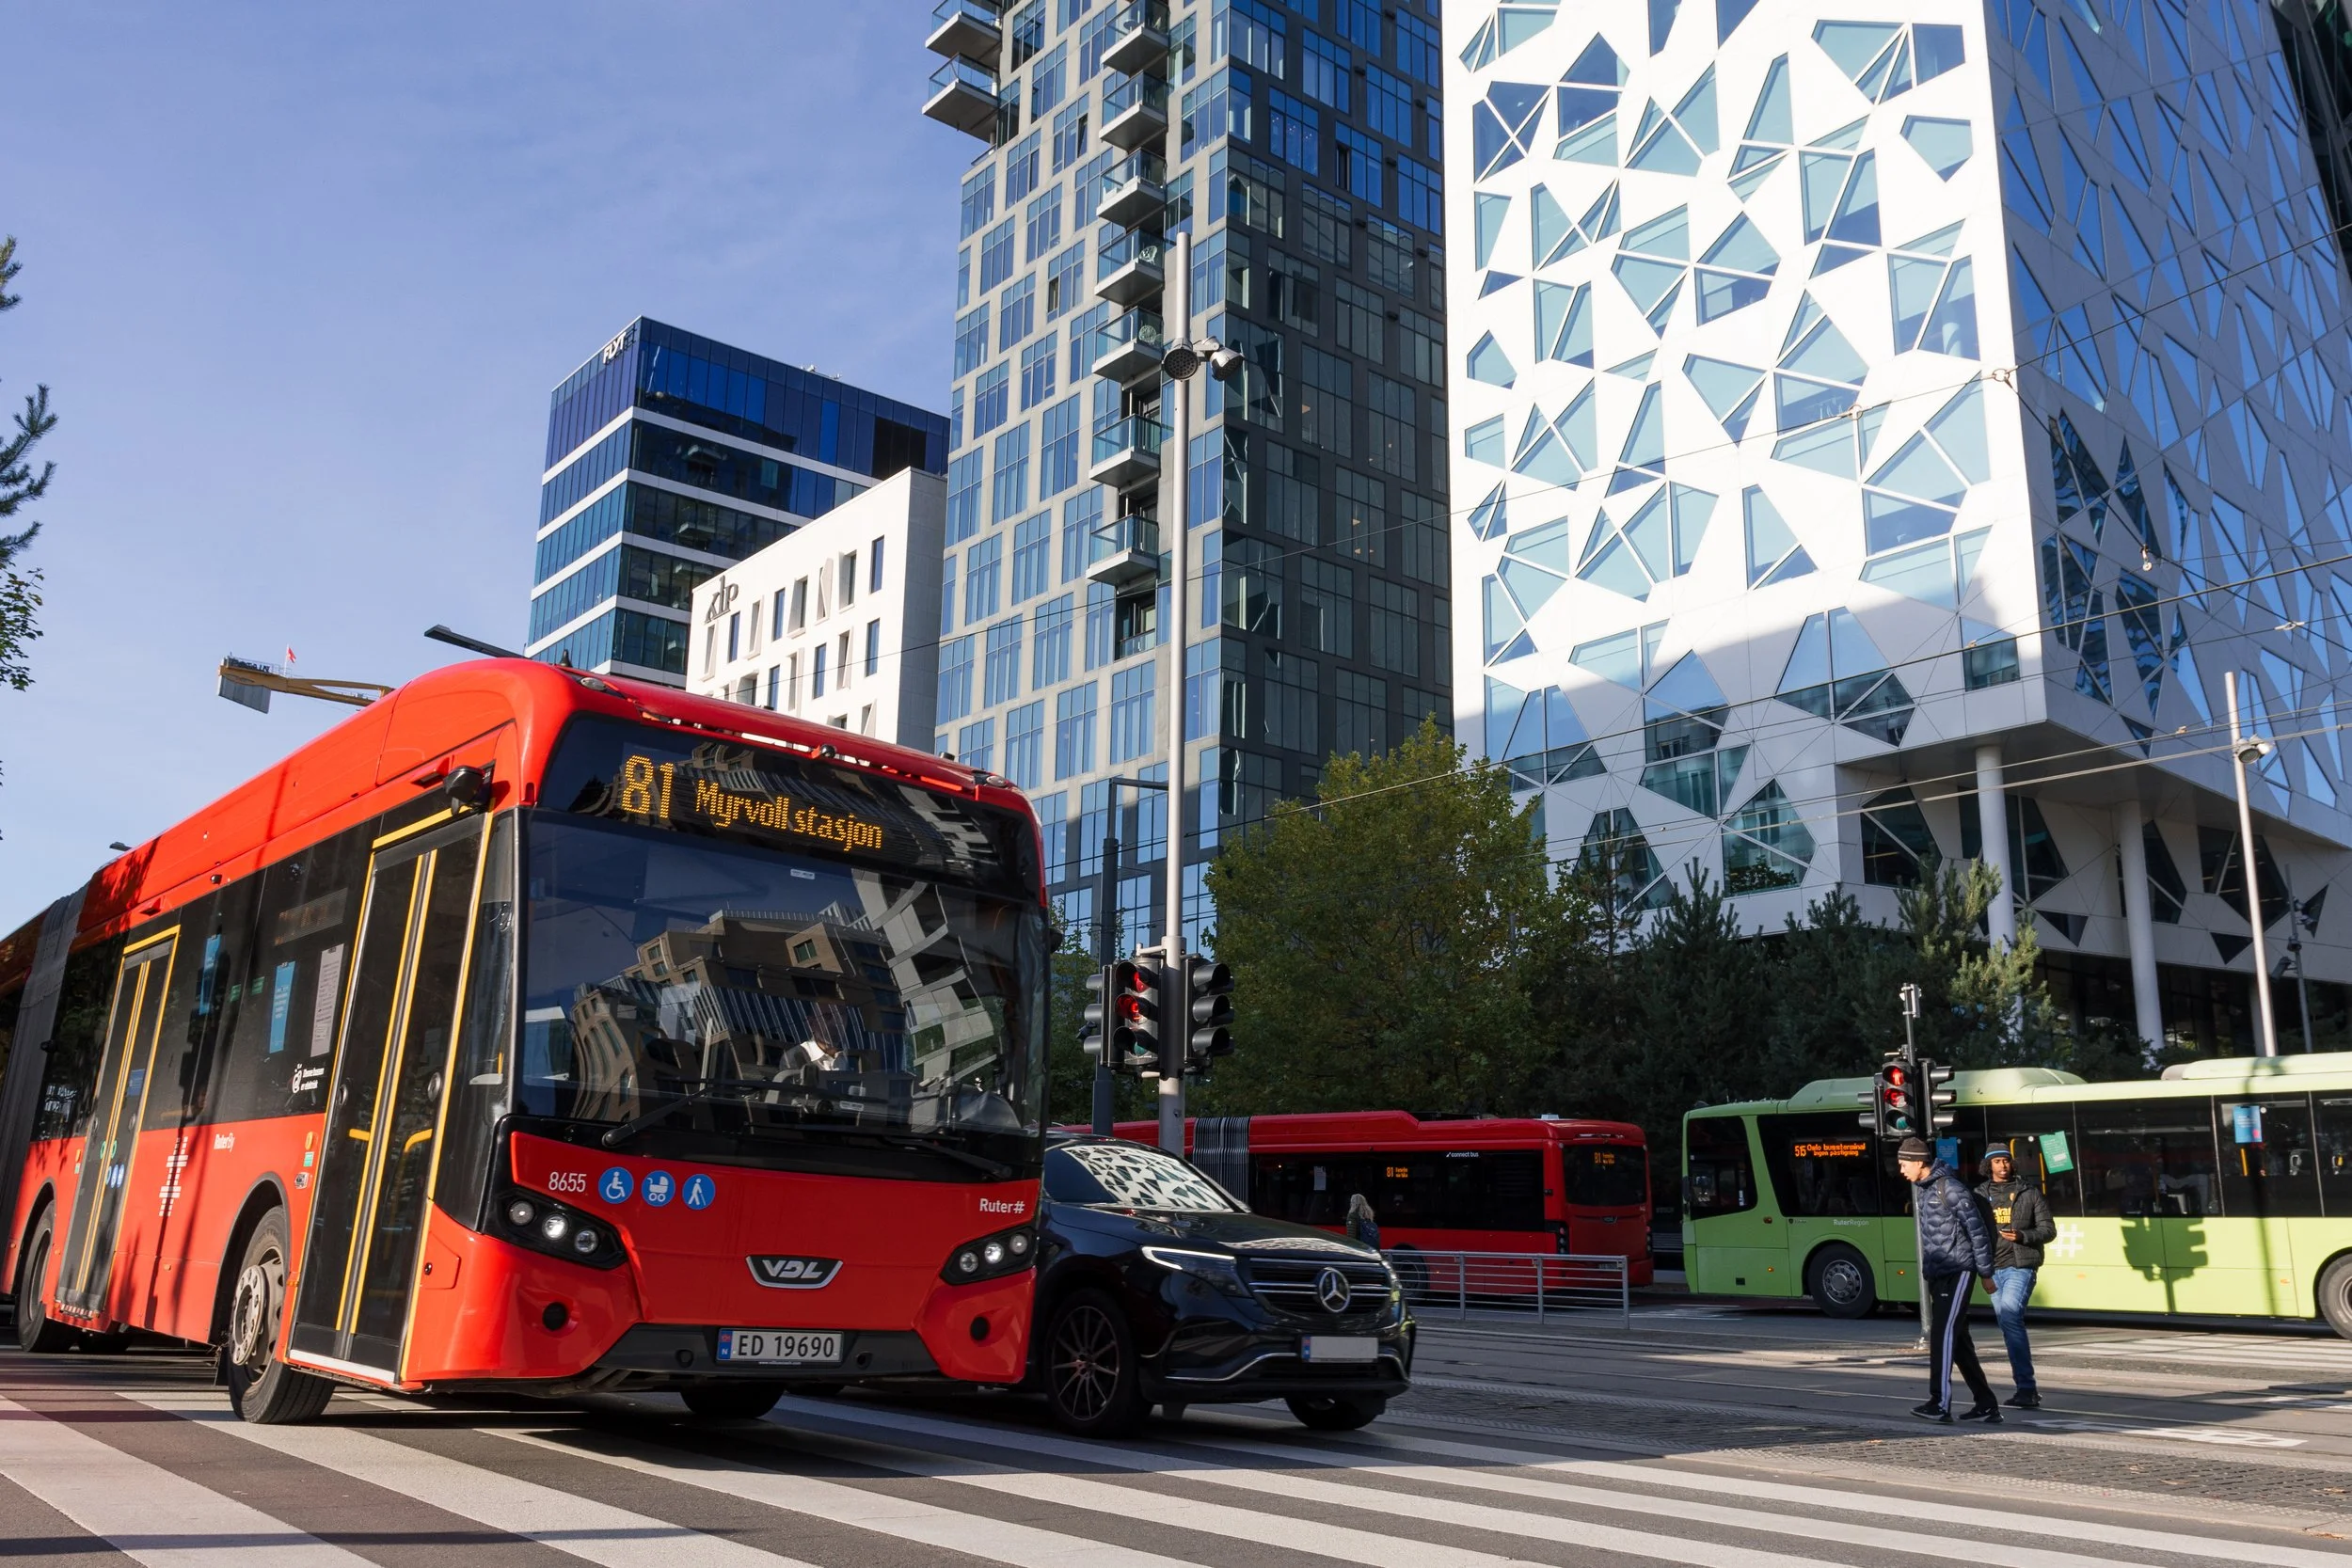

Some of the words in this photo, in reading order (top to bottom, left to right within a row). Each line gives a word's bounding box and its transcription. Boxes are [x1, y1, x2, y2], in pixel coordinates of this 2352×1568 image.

[621, 754, 675, 819] 81
[694, 779, 789, 828] Myrvoll
[793, 806, 882, 852] stasjon
[548, 1172, 587, 1193] 8655
[1386, 1166, 1393, 1178] 81
[761, 1259, 824, 1279] VDL
[738, 1334, 764, 1356] ED
[774, 1335, 834, 1358] 19690
